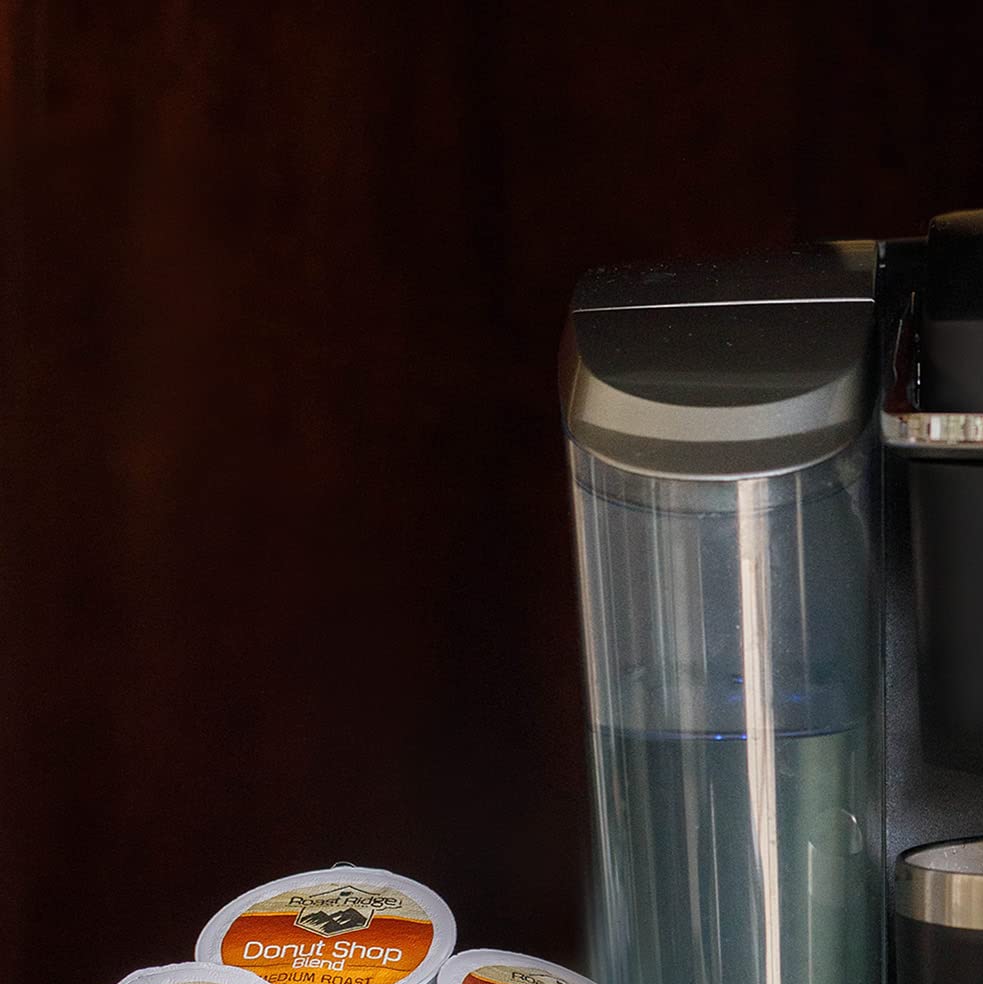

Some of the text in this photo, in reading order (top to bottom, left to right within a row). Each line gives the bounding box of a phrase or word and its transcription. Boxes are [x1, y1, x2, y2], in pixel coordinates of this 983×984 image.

[289, 896, 398, 909] Roast Ridge
[243, 940, 402, 965] Donut Shop
[292, 957, 345, 971] Blend
